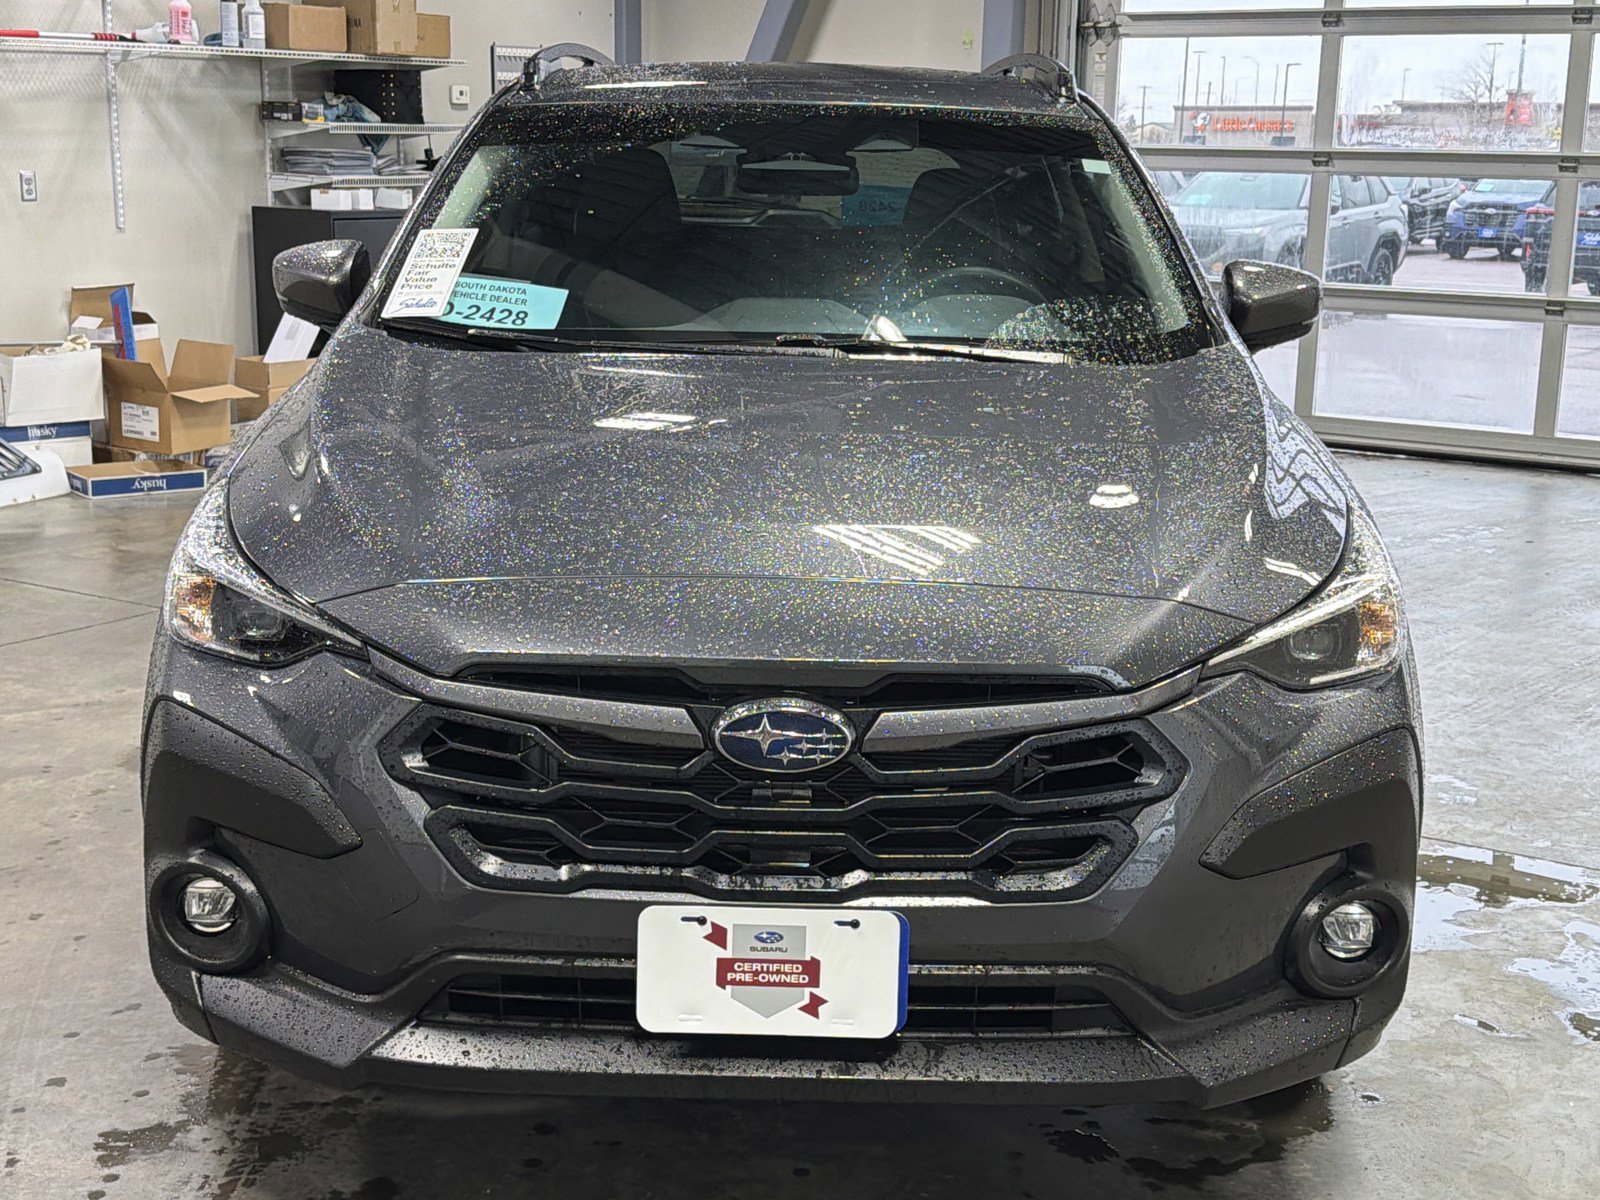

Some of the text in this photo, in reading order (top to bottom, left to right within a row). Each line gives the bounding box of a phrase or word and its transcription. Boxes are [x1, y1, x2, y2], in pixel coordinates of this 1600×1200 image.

[1212, 115, 1244, 131] Little
[454, 280, 527, 296] SOUTH DAKOTA
[489, 294, 528, 306] DEALER
[132, 478, 167, 491] husky
[733, 962, 803, 973] CERTIFIED
[726, 973, 809, 984] PRE-OWNED
